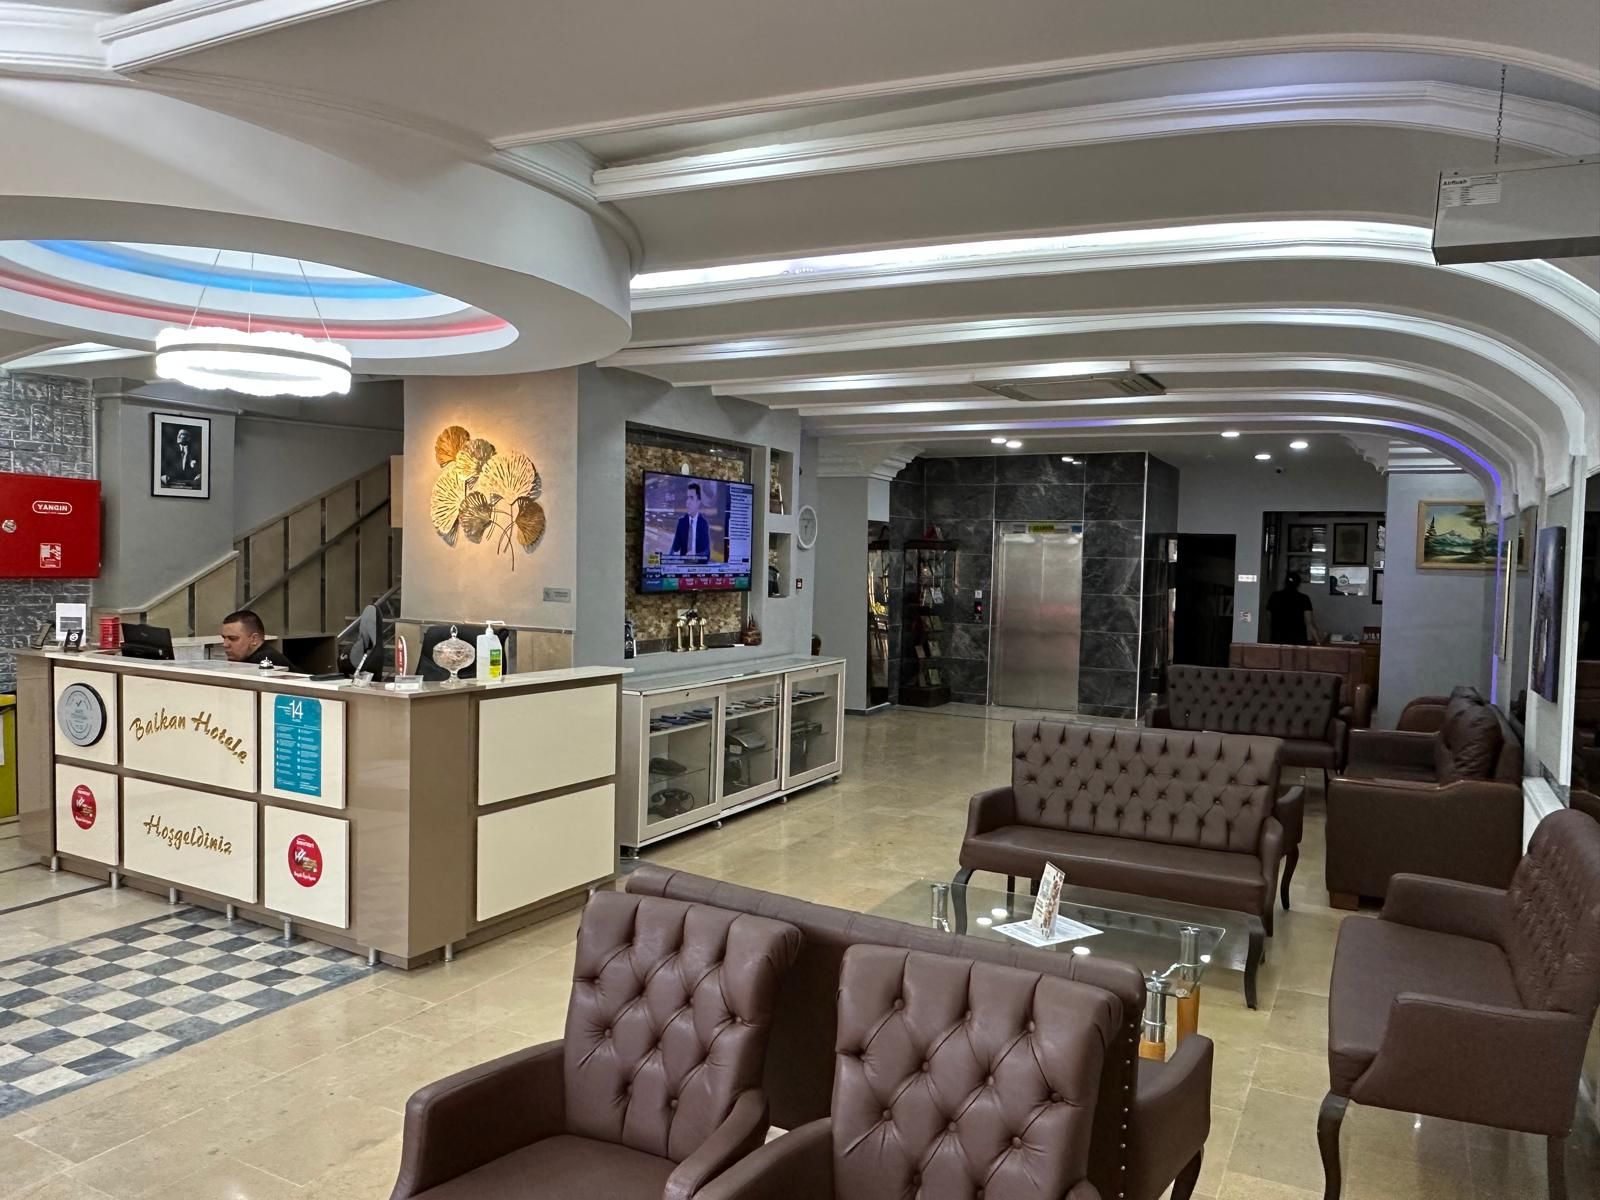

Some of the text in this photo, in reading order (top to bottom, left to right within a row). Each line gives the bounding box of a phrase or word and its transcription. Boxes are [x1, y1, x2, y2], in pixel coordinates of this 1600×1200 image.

[37, 503, 68, 512] YANGIN
[289, 699, 304, 720] 14
[129, 707, 187, 742] Balkan
